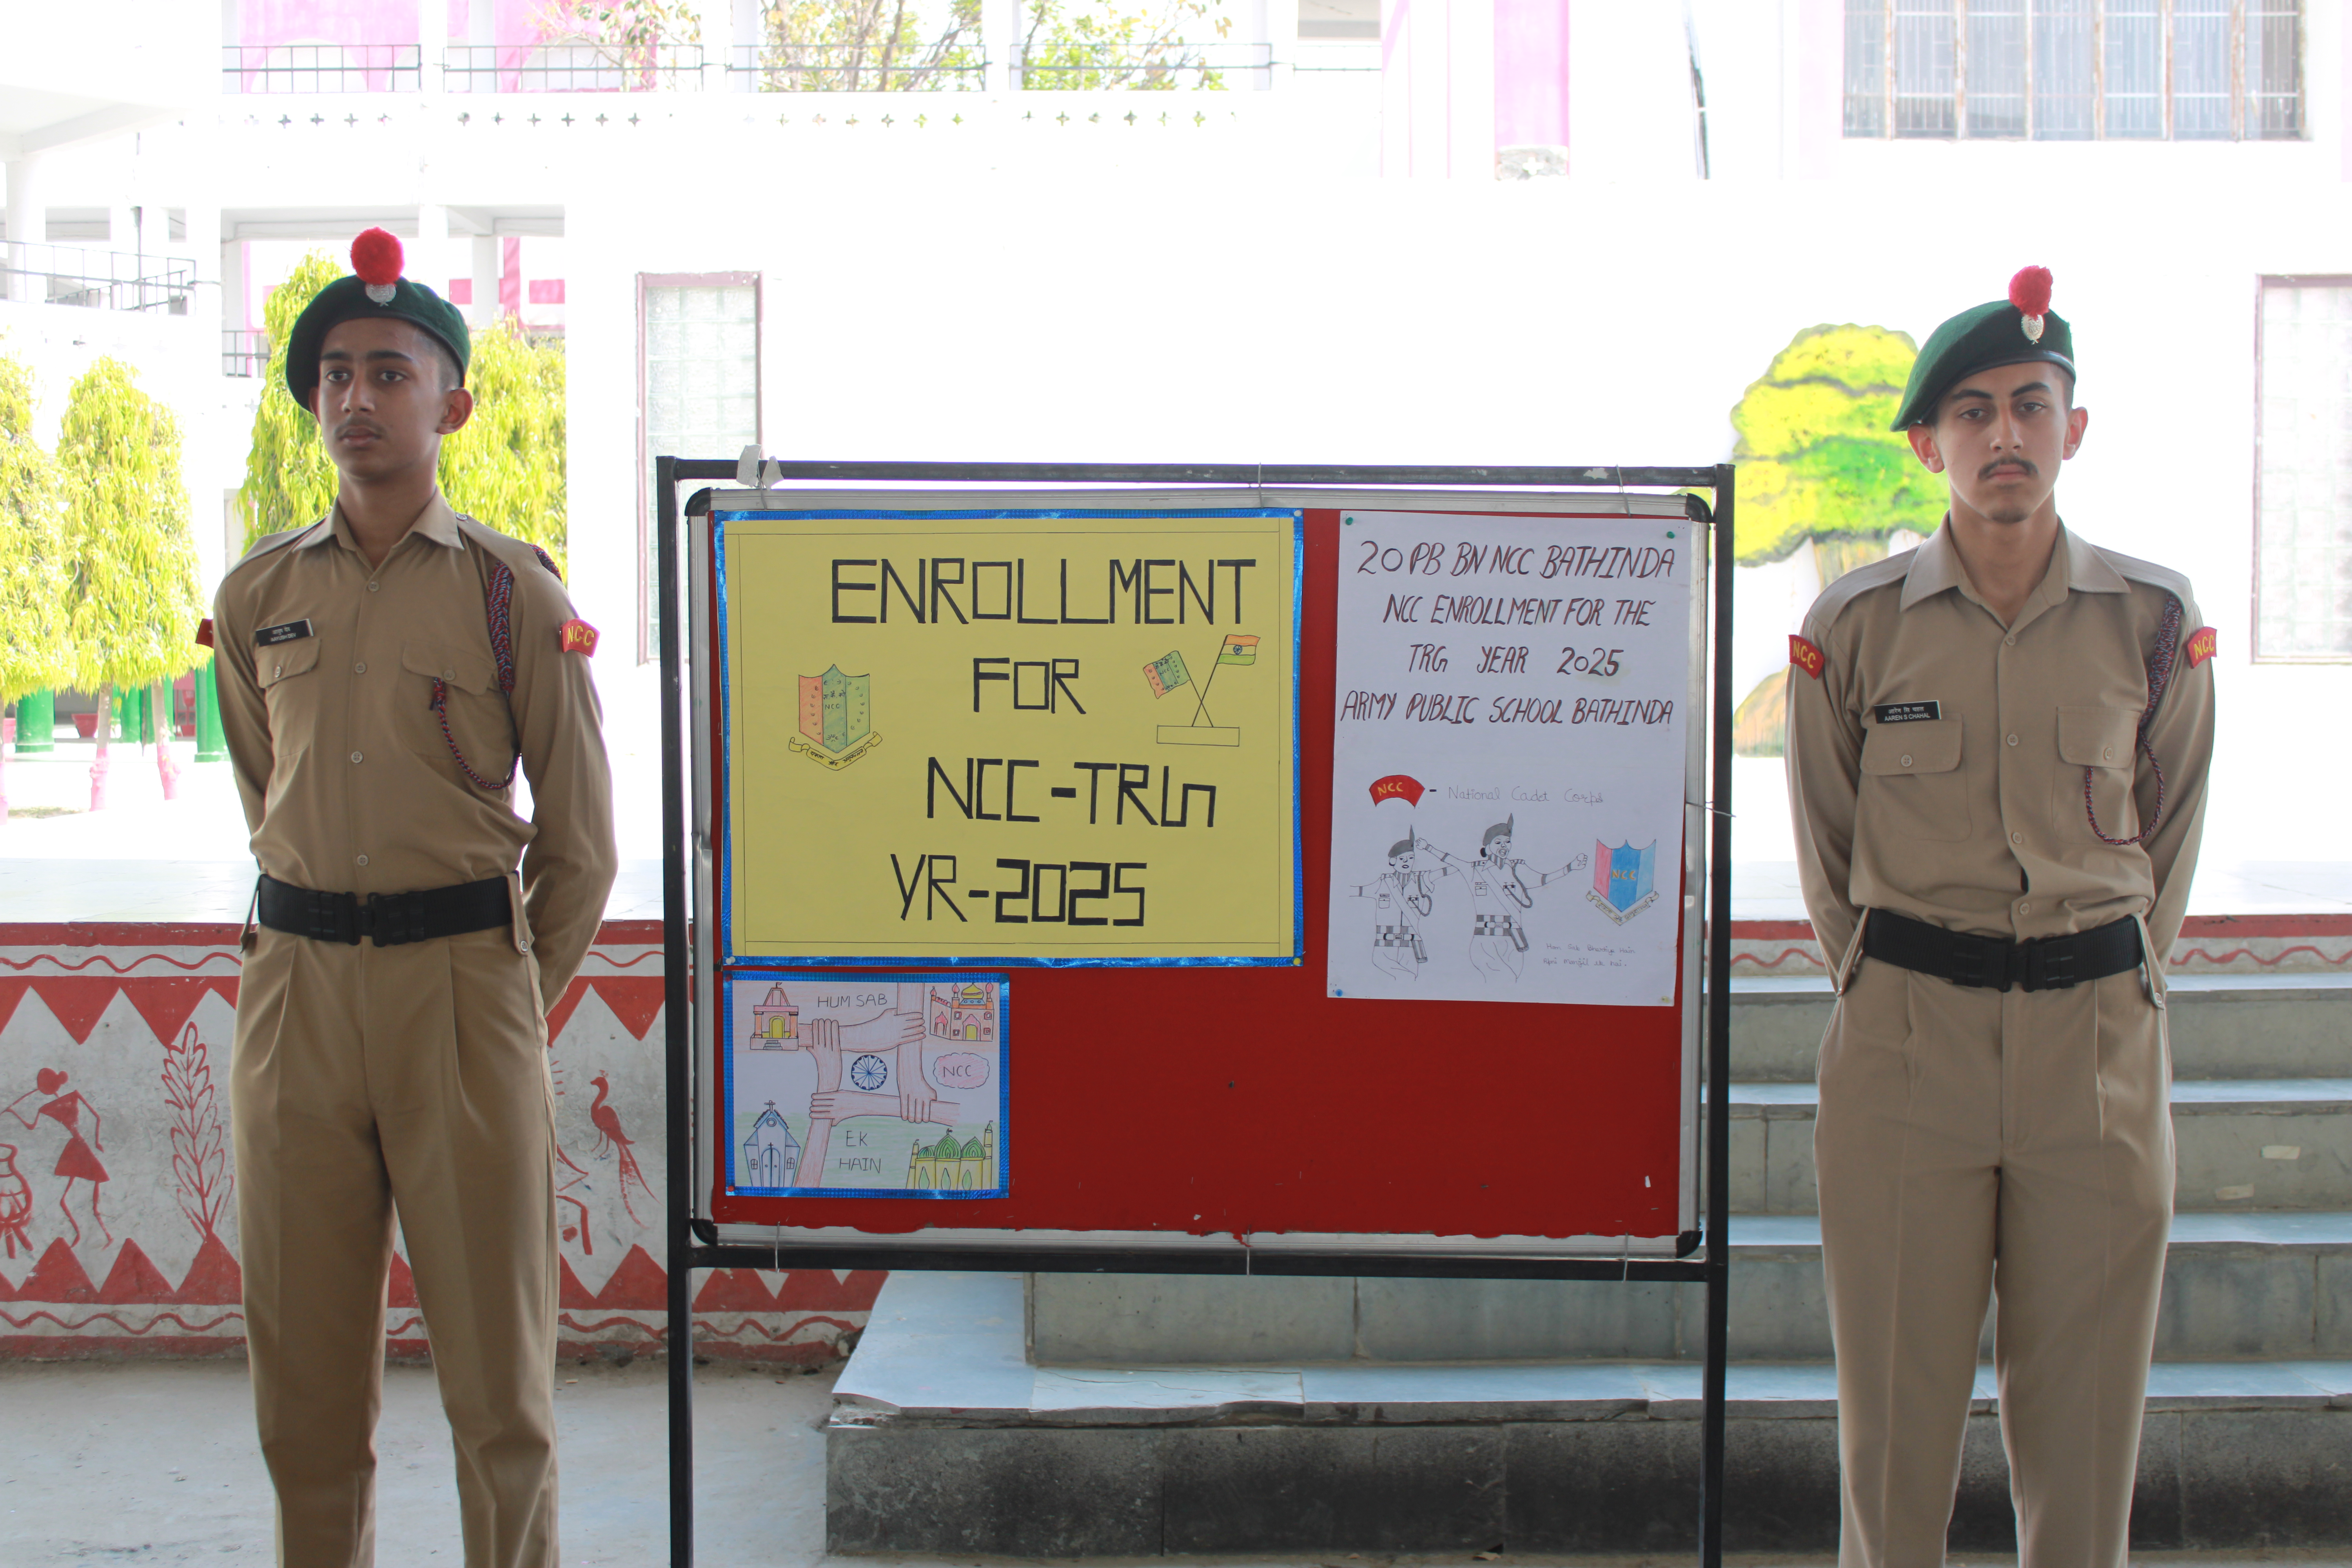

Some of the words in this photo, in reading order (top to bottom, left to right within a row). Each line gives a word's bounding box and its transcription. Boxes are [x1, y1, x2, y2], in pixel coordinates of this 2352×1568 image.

[1357, 541, 1403, 574] 20
[1410, 543, 1445, 575] PB
[1450, 542, 1487, 576] BN
[1489, 545, 1534, 575] NCC
[1540, 545, 1674, 579] BATHINDA
[832, 558, 1256, 625] ENROLLMENT
[1383, 594, 1423, 623] NCC
[1431, 595, 1563, 625] ENROLLMENT
[1563, 598, 1604, 626] FOR
[1614, 600, 1656, 626] THE
[568, 625, 594, 646] NCC
[2194, 635, 2214, 659] NCC
[1409, 644, 1448, 672] TRG
[1477, 646, 1528, 673] YEAR
[1557, 647, 1624, 676] 2025
[1793, 640, 1816, 669] NCC
[973, 658, 1086, 714] FOR
[1341, 690, 1397, 721] ARMY
[1406, 693, 1479, 724] PUBLIC
[1489, 697, 1562, 724] SCHOOL
[1572, 698, 1673, 725] BATHINDA
[1377, 782, 1403, 796] NCC
[1449, 785, 1500, 800] National
[1512, 786, 1549, 802] Cadet
[1565, 789, 1603, 806] Corps
[1612, 869, 1636, 880] NCC
[890, 854, 1147, 926] YR-2025
[818, 996, 850, 1007] HUM
[857, 994, 887, 1007] SAB
[944, 1065, 971, 1077] NCC
[846, 1131, 867, 1146] EK
[840, 1158, 880, 1173] HAIN
